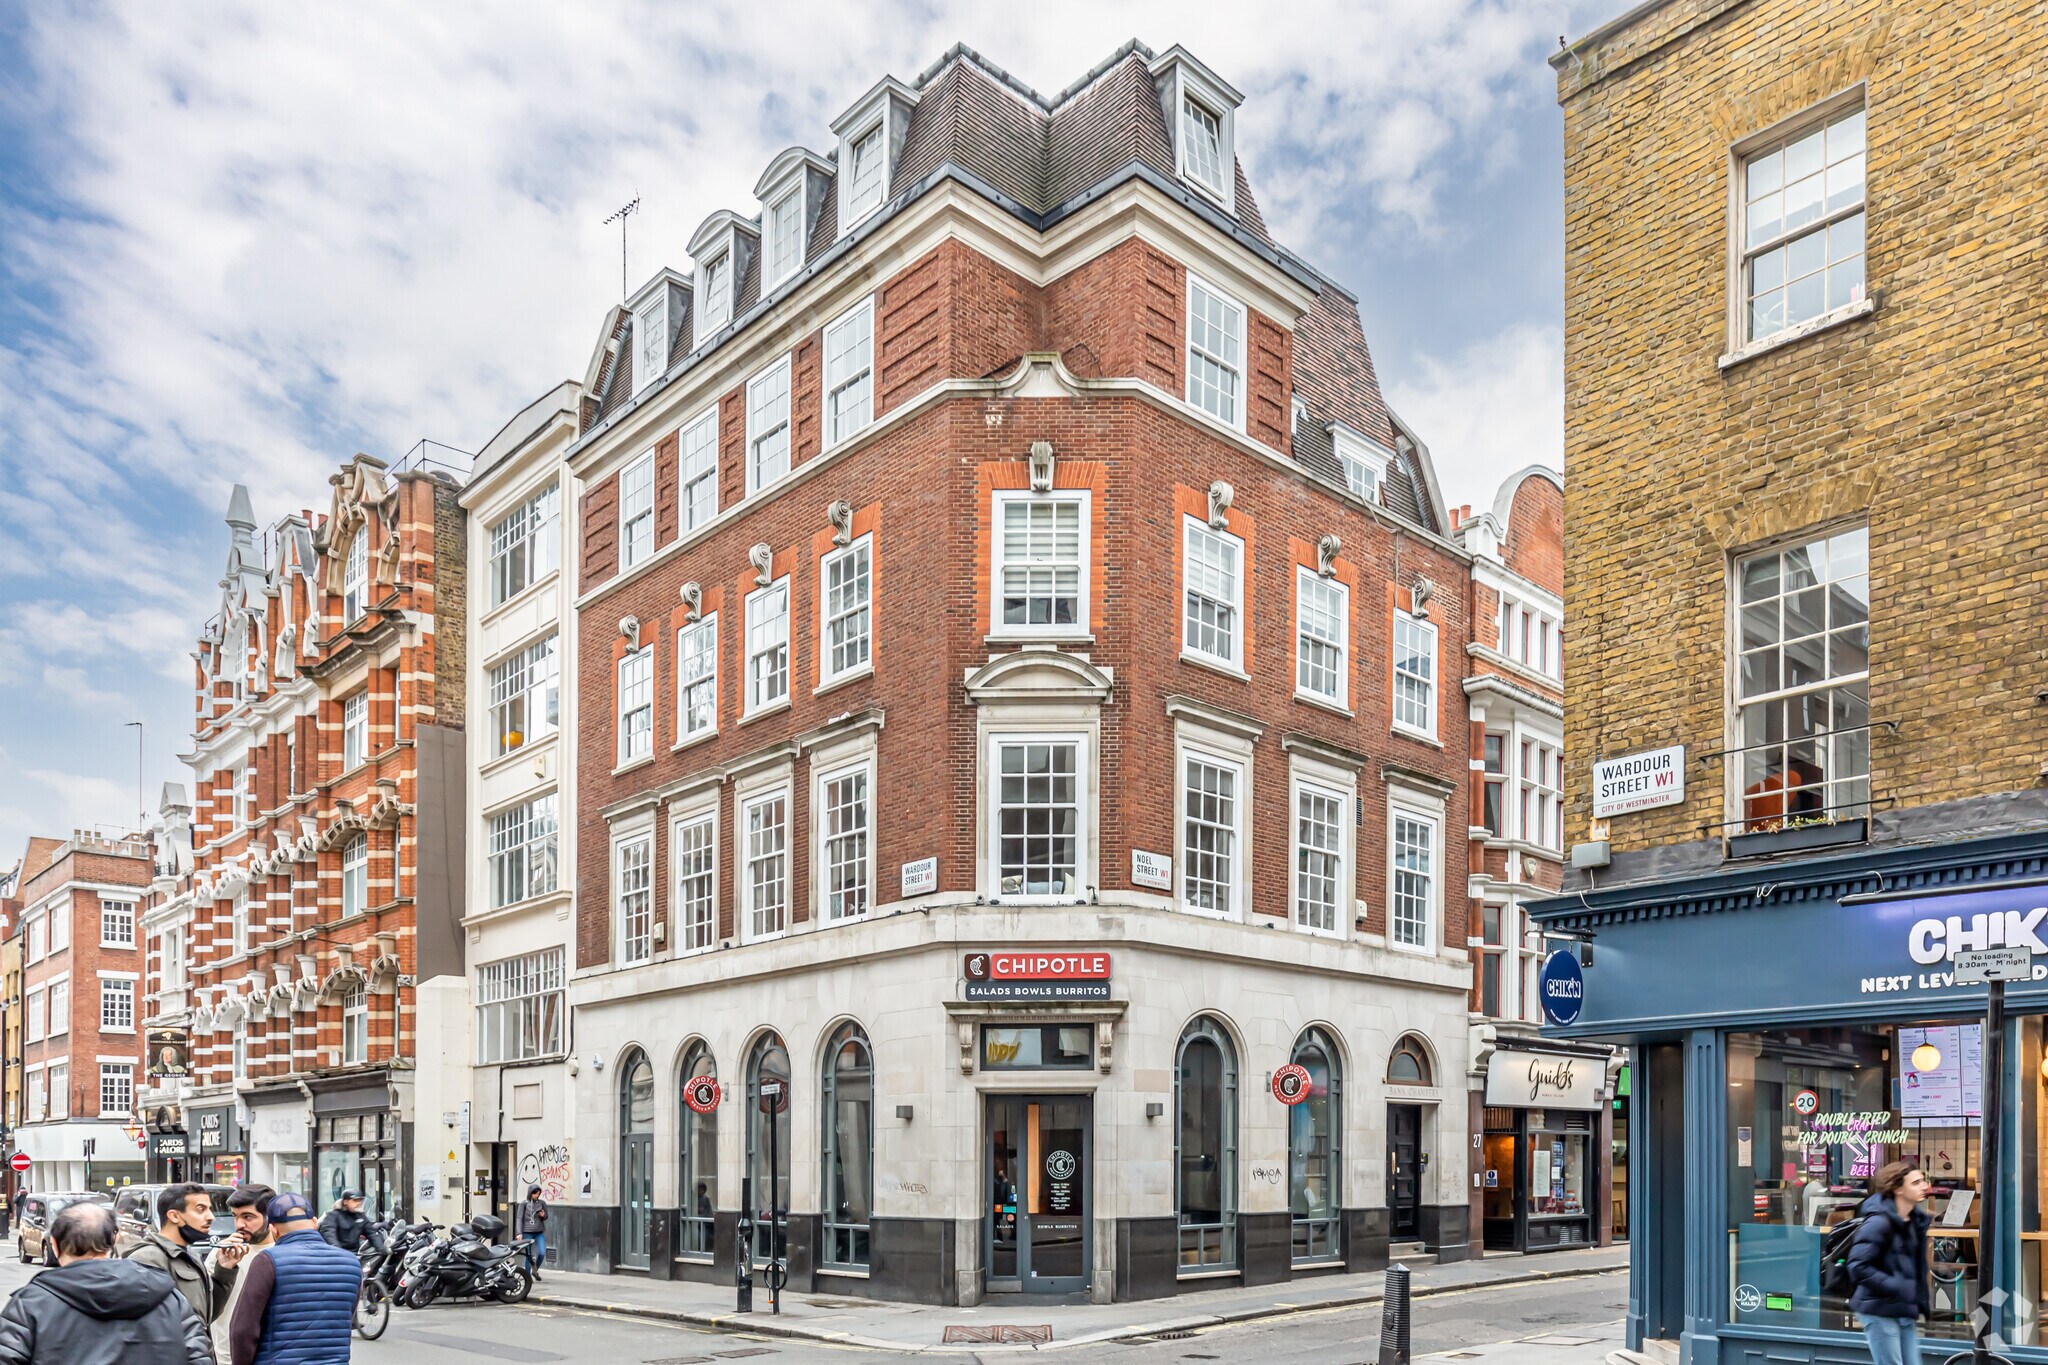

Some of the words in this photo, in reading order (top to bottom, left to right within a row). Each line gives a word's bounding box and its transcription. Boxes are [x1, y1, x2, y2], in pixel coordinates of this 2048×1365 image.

[1602, 754, 1671, 780] WARDOUR
[1602, 776, 1650, 797] STREET
[1655, 771, 1673, 787] W1
[1601, 804, 1614, 813] CITY
[1626, 794, 1670, 808] WESTMINSTER
[1138, 854, 1152, 865] NOEL
[905, 861, 932, 875] WARDOUR
[1137, 865, 1158, 876] STREET
[1160, 870, 1168, 878] W1
[905, 873, 923, 885] STREET
[925, 872, 933, 881] W1
[996, 958, 1105, 974] CHIPOTLE
[1957, 961, 1988, 969] 8.30am
[1996, 958, 2026, 966] M'night
[970, 987, 1011, 995] SALADS
[1014, 987, 1052, 995] BOWLS
[1055, 987, 1107, 995] BURRITOS
[1546, 977, 1581, 998] CHIK'N
[1861, 975, 1912, 993] NEXT
[1275, 1065, 1309, 1085] CHIPOTLE
[687, 1076, 719, 1095] CHIPOTLE
[1389, 1087, 1406, 1096] BANK
[1408, 1087, 1439, 1097] CHAMBERS
[1273, 1084, 1291, 1103] MEXICAN
[690, 1099, 711, 1111] MEXICAN
[1797, 1097, 1815, 1108] 20
[201, 1114, 220, 1129] CARDS
[1815, 1112, 1857, 1126] DOUBLE
[1860, 1111, 1891, 1126] FRIED
[1473, 1133, 1481, 1148] 27
[1797, 1131, 1818, 1144] FOR
[1863, 1129, 1910, 1144] CRUNCH
[1850, 1164, 1876, 1177] BEER
